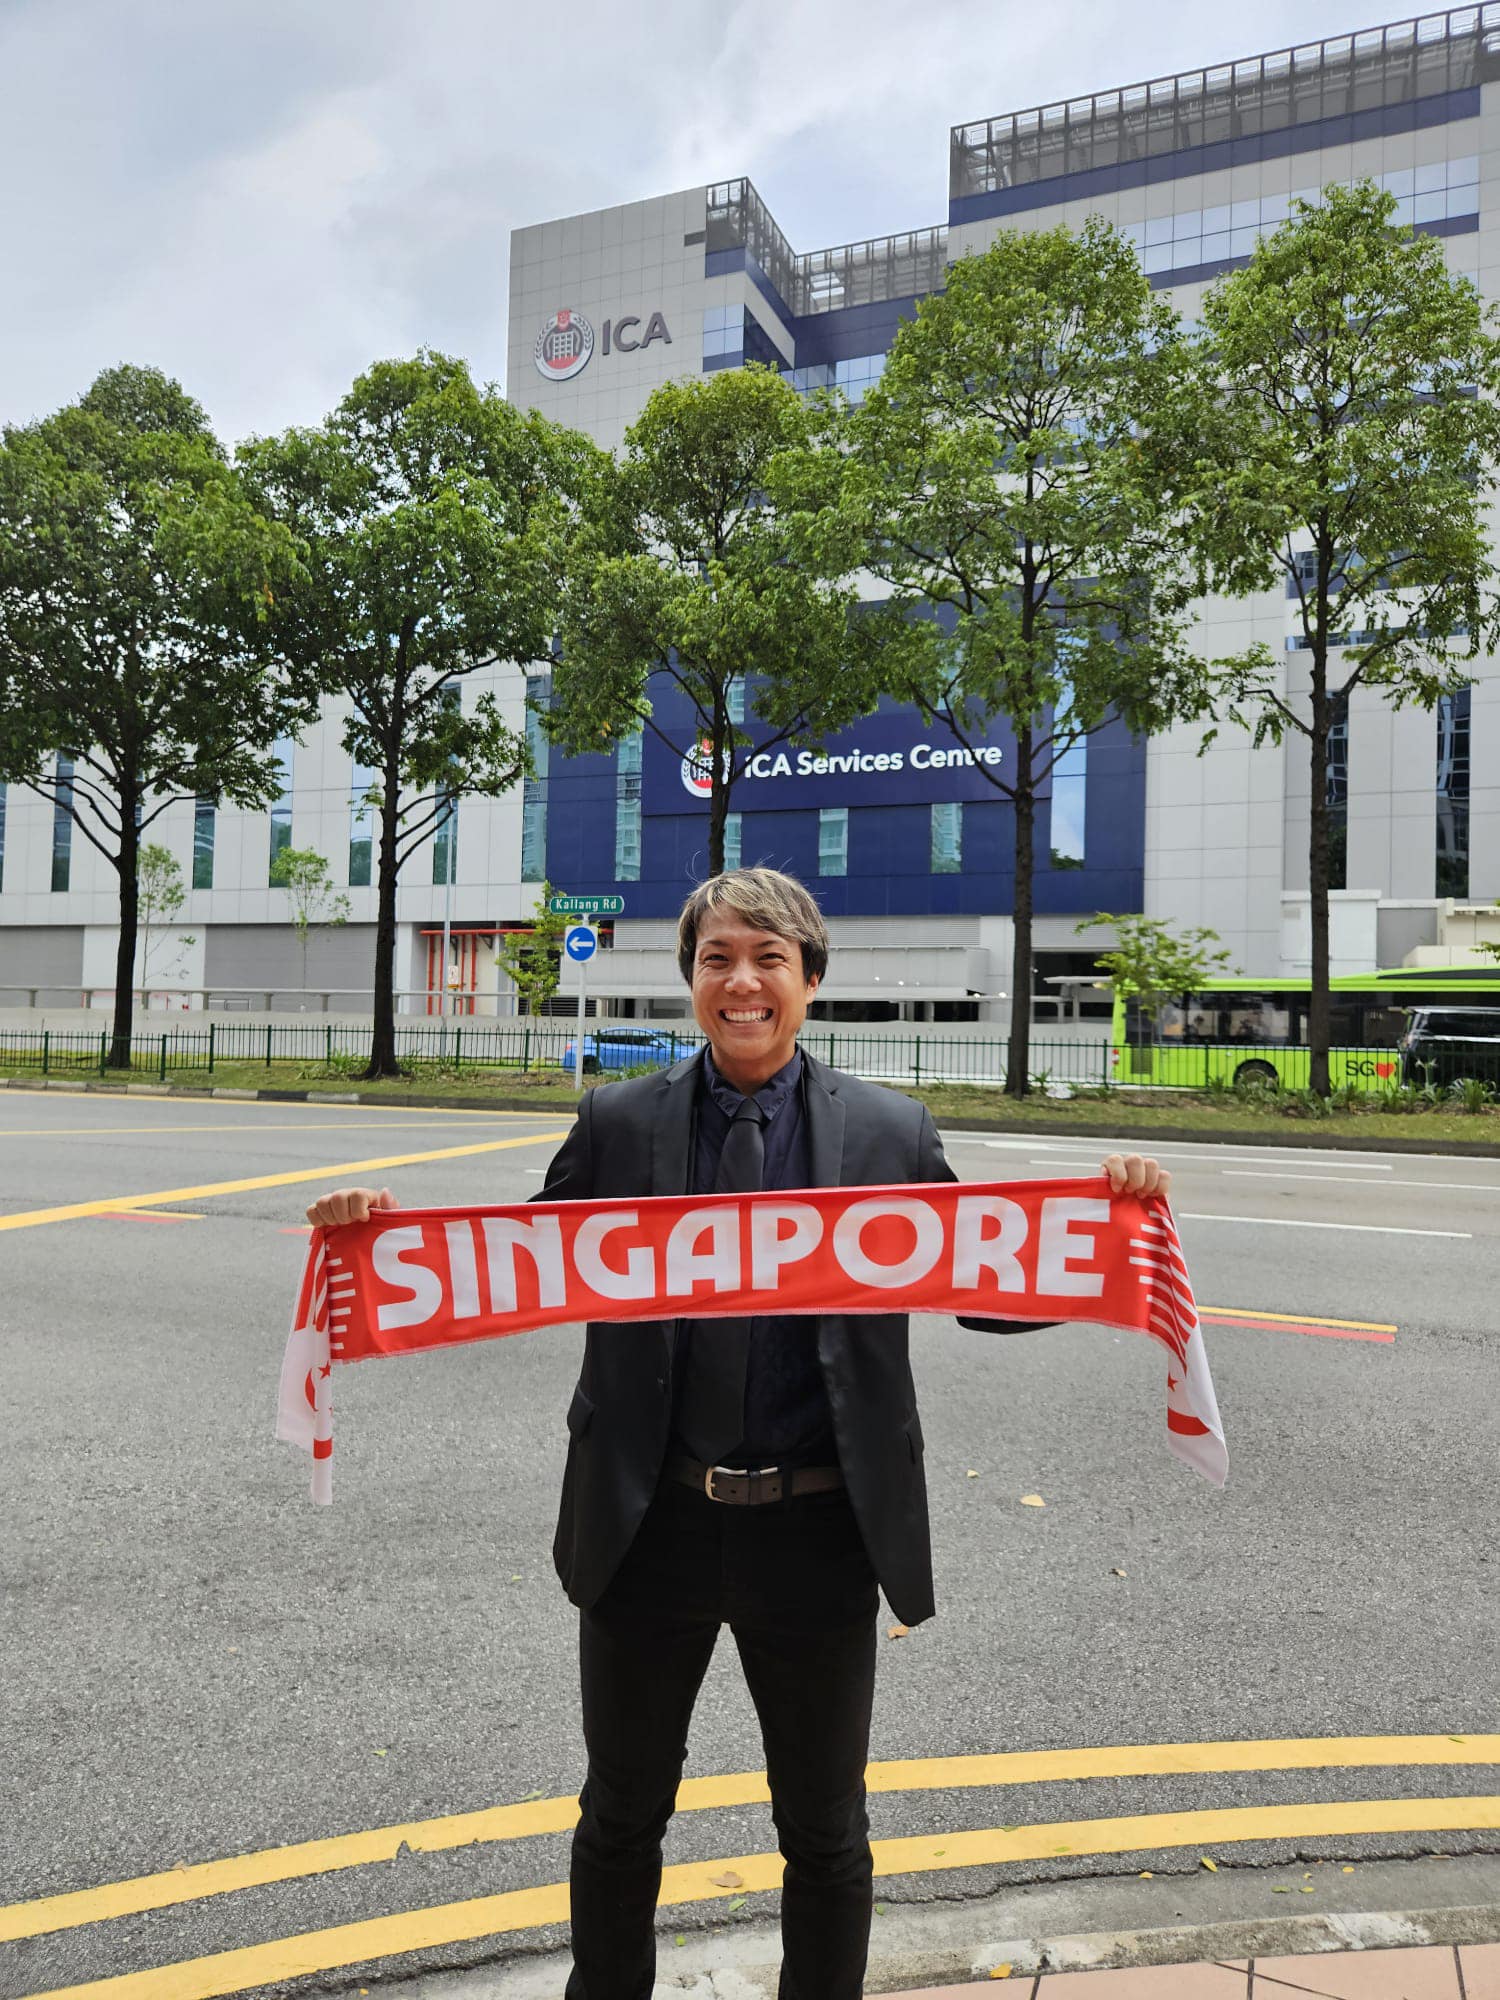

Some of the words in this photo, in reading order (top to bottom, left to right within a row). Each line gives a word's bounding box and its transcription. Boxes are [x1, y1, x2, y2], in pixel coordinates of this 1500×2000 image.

[602, 311, 672, 356] ICA
[744, 753, 793, 778] ICA
[796, 749, 903, 776] Services
[910, 743, 1003, 769] Centre
[556, 898, 599, 911] Kallang
[603, 898, 617, 909] Rd
[1346, 1060, 1375, 1077] SG
[372, 1194, 1111, 1331] SINGAPORE
